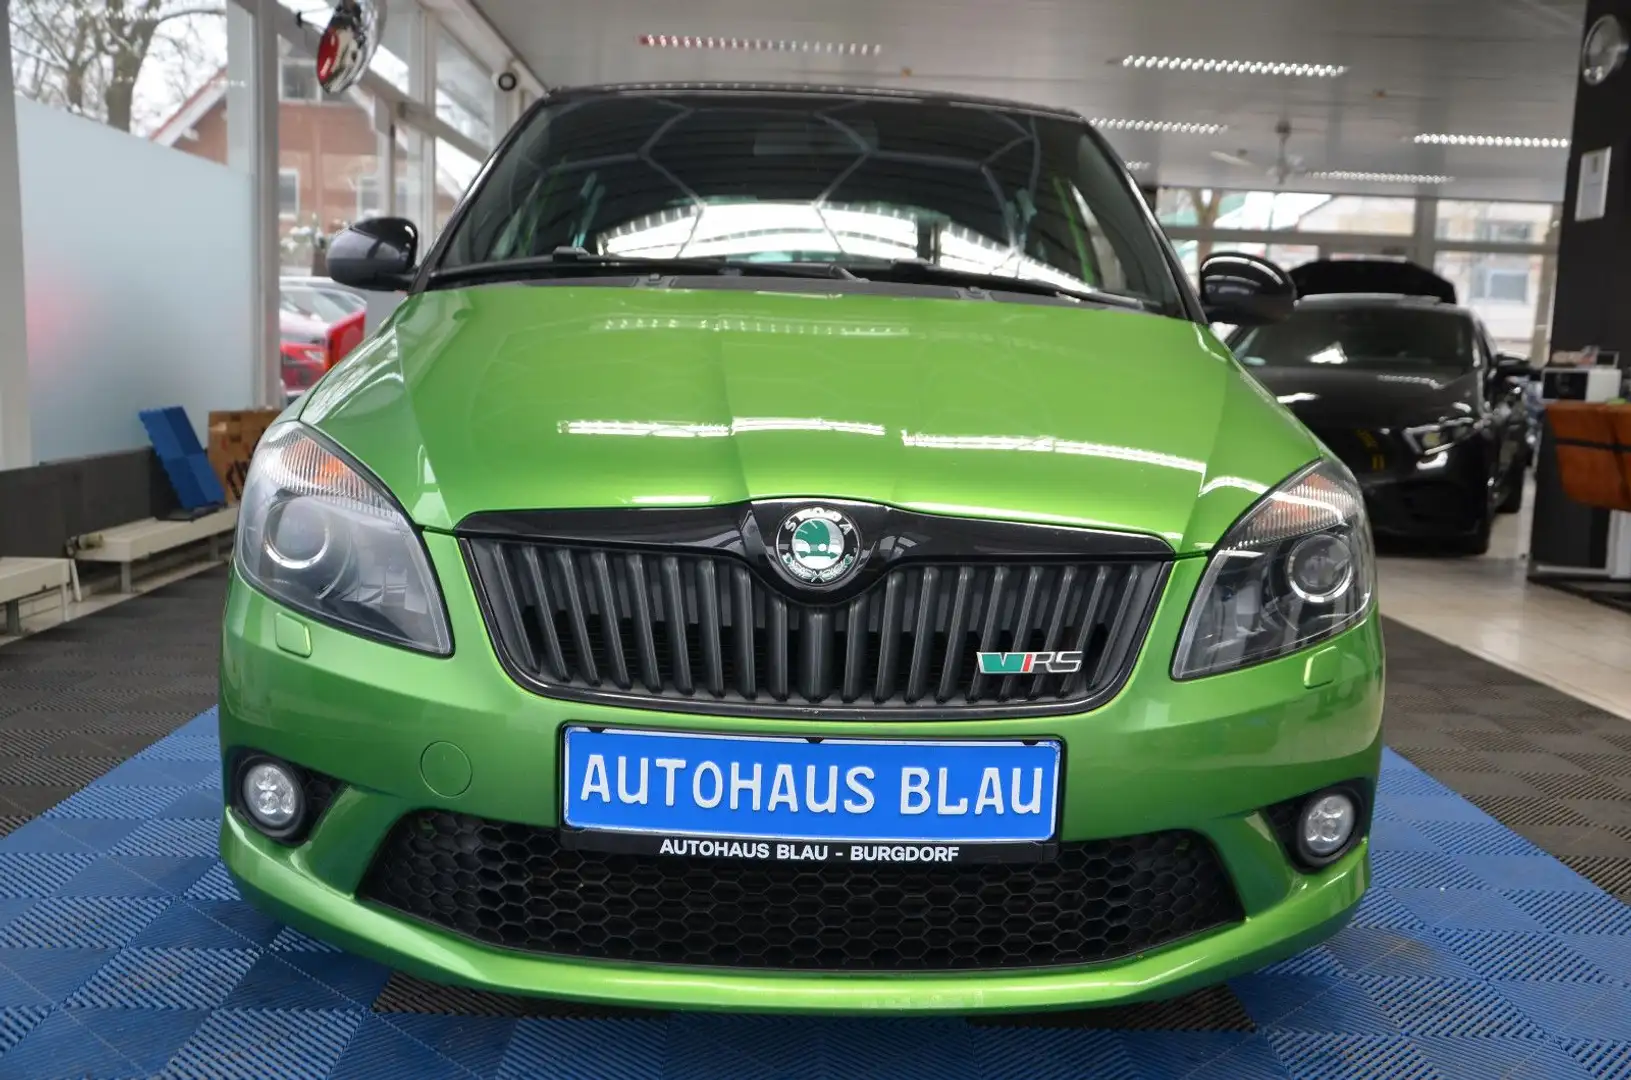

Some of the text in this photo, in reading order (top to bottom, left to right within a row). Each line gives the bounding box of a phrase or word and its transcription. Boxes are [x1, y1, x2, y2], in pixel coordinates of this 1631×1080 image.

[580, 754, 1043, 815] AUTOHAUS BLAU
[659, 839, 770, 859] AUTOHAUS
[776, 844, 829, 861] BLAU
[850, 845, 960, 863] BURGDORF
